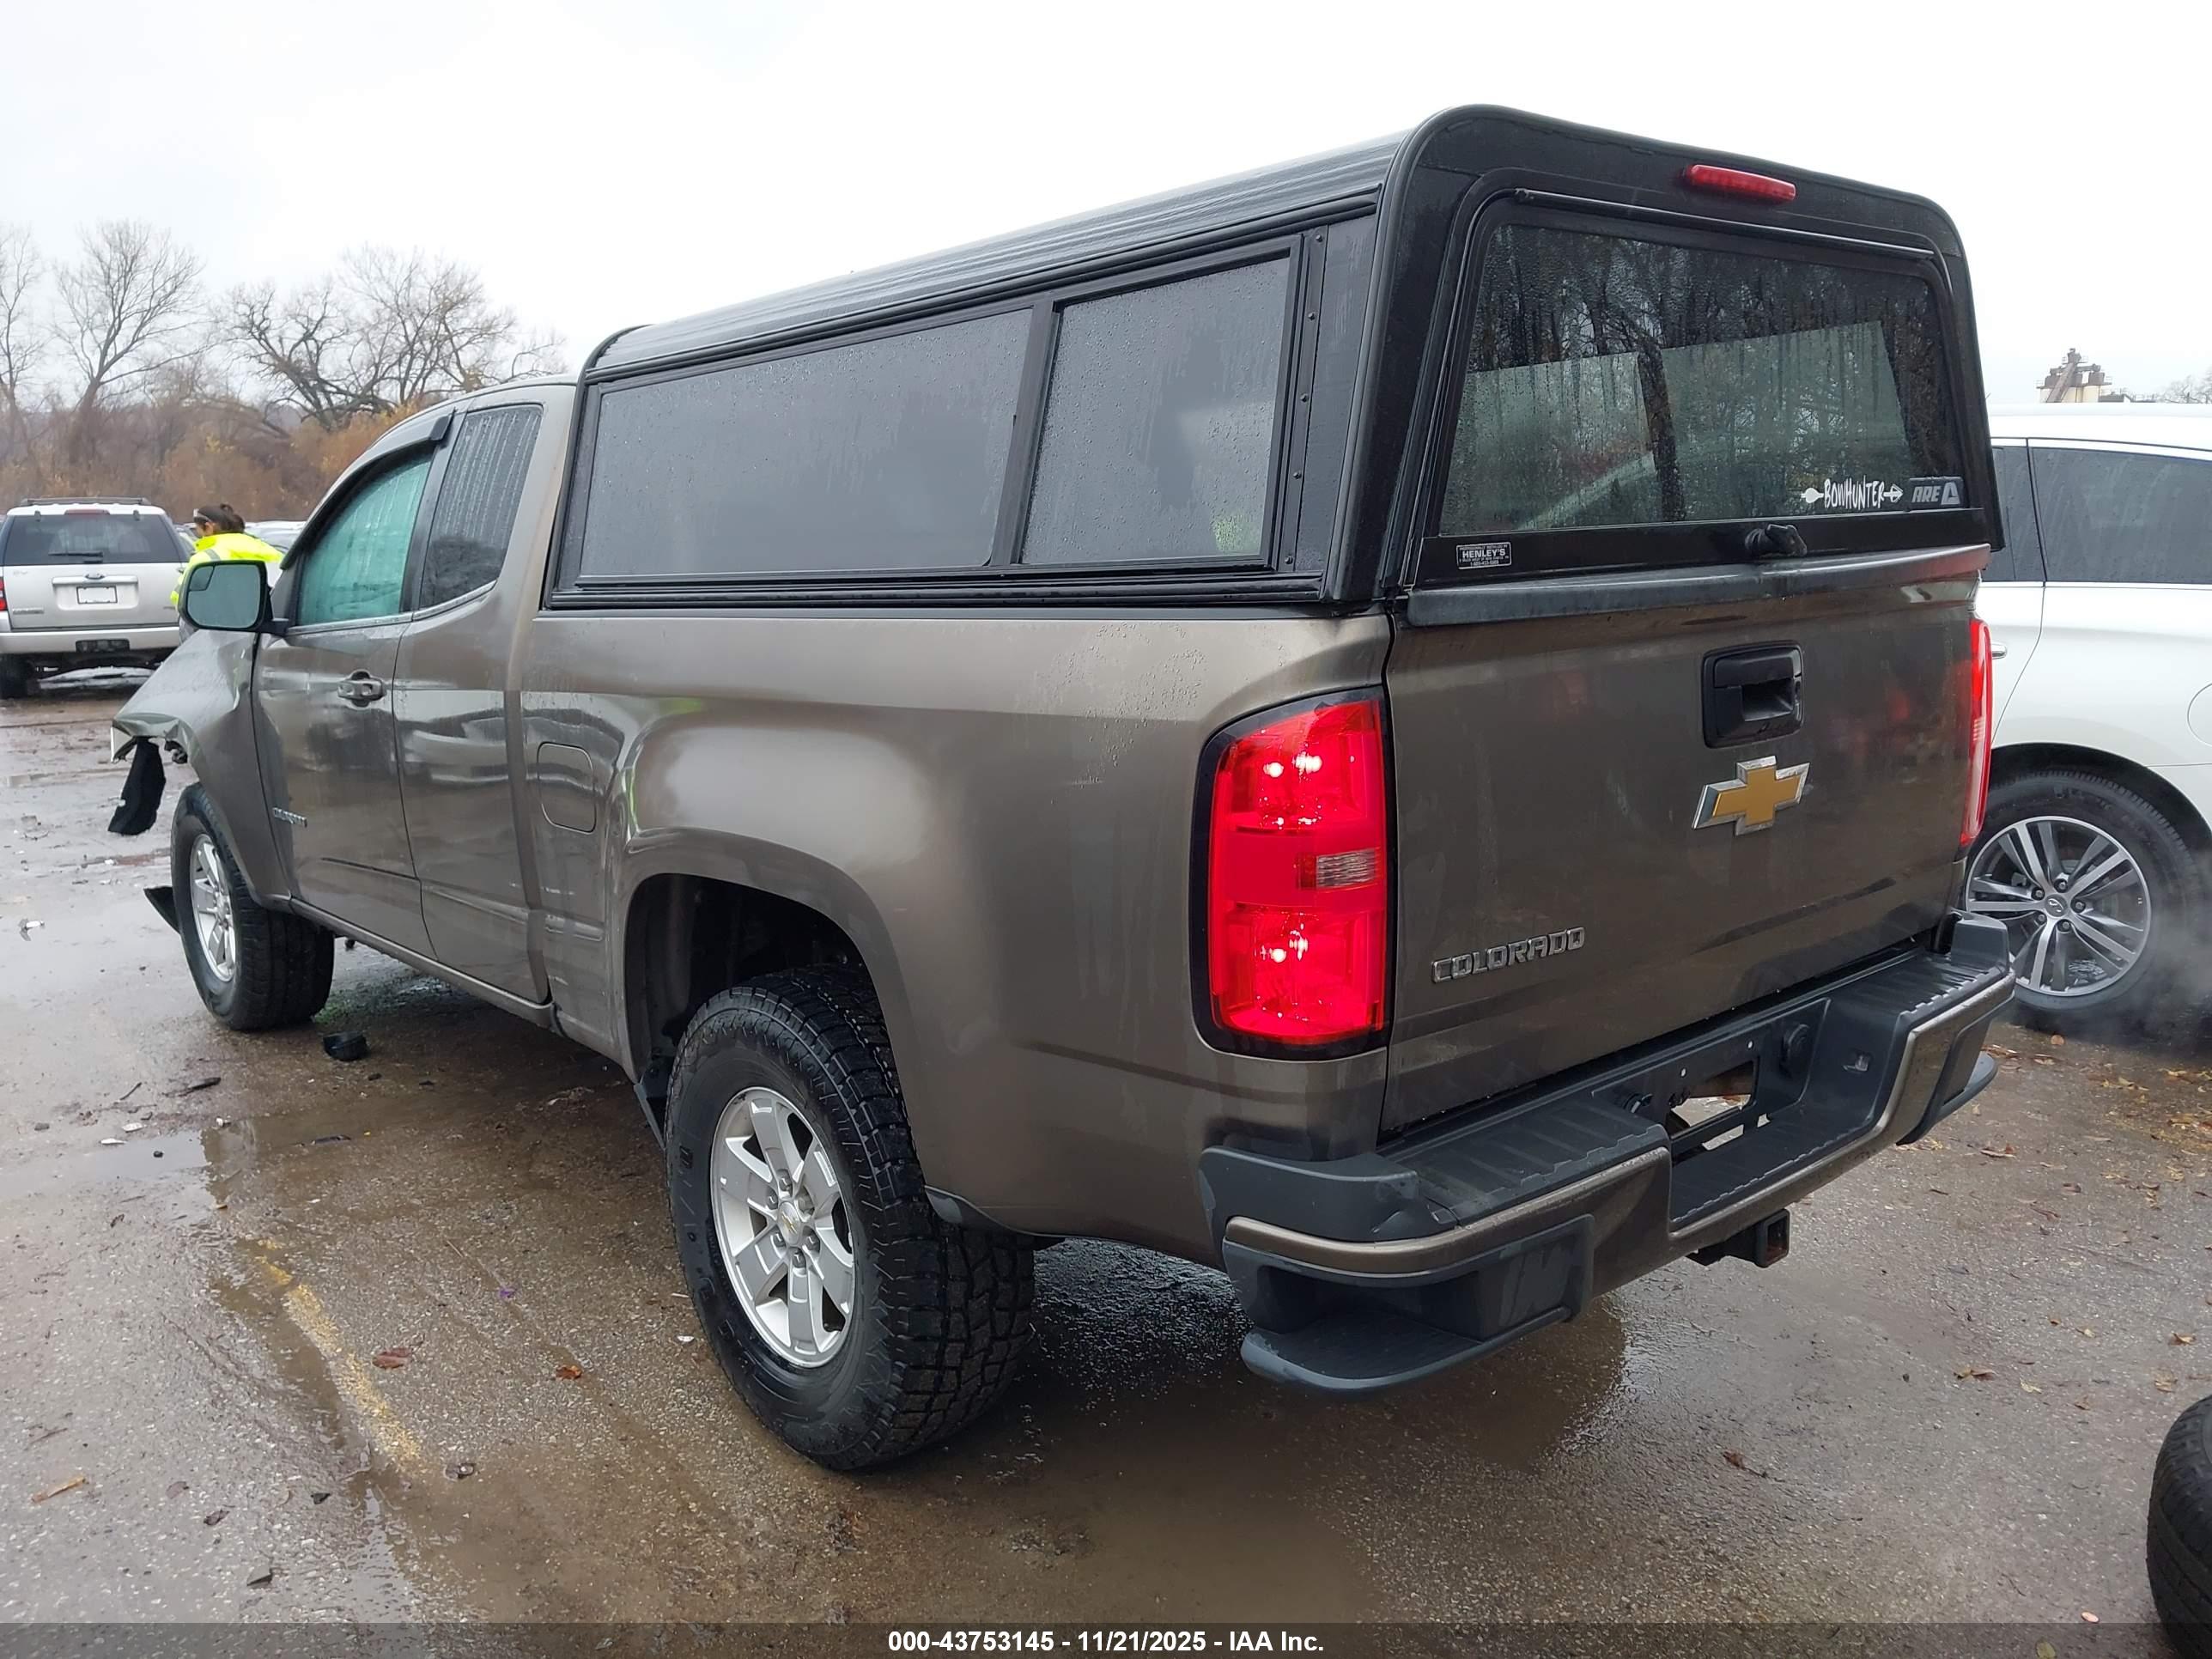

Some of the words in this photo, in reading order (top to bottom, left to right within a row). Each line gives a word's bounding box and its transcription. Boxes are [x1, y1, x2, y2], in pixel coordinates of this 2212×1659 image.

[1824, 475, 1885, 510] BOWHUNTER
[1911, 485, 1942, 503] ARE
[1462, 548, 1506, 558] HENLEY'S
[1431, 927, 1586, 983] COLORADO
